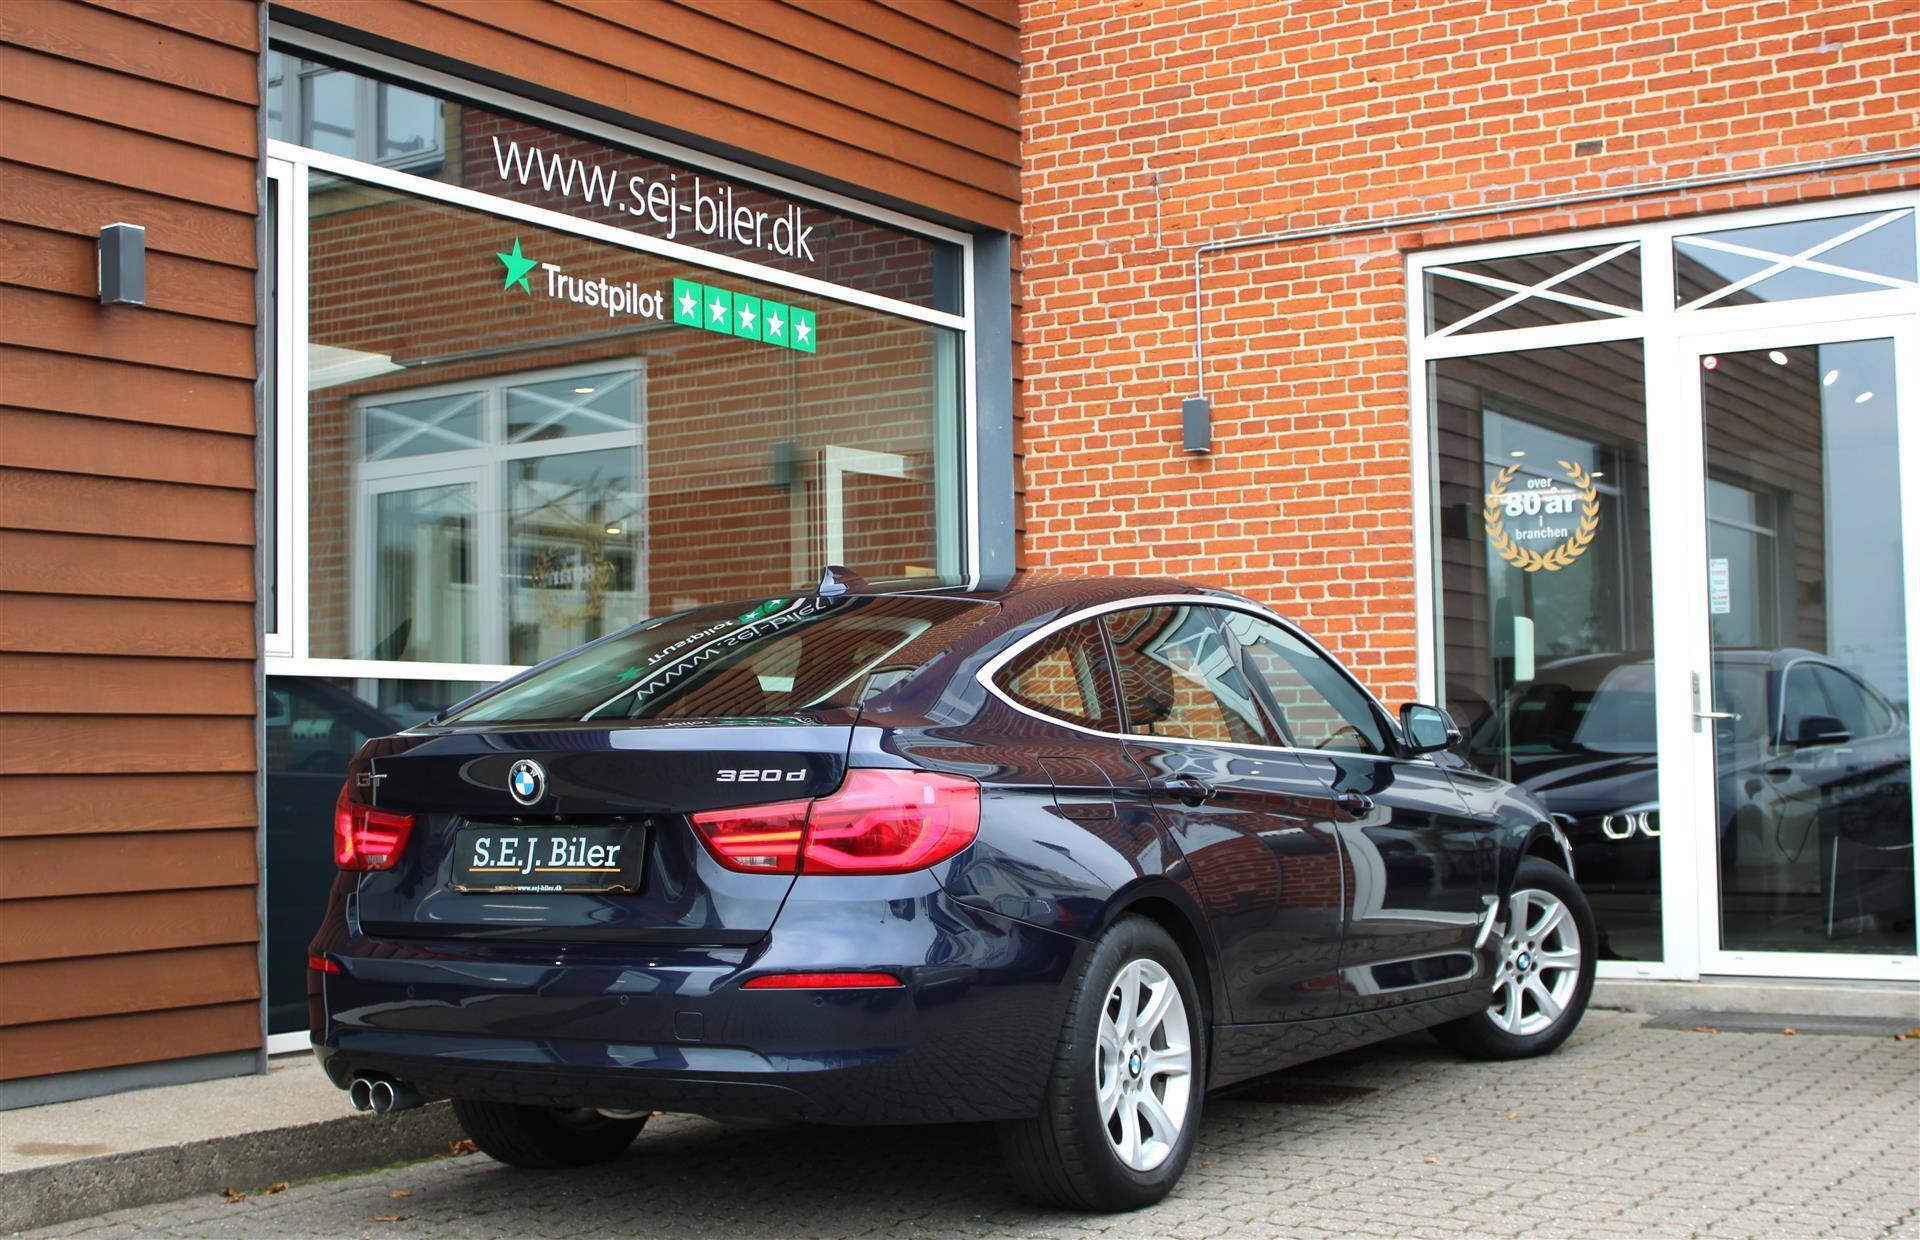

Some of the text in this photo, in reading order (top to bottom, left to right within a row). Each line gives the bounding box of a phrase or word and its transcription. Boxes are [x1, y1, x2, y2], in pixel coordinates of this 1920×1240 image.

[492, 135, 815, 262] www.sej-biler.dk
[541, 262, 664, 320] Trustpilot
[1527, 478, 1553, 489] over
[1505, 487, 1577, 517] 80 år
[1539, 515, 1543, 527] i
[1515, 527, 1568, 540] branchen
[356, 772, 388, 787] GT
[473, 836, 621, 875] S.E.J. Biler
